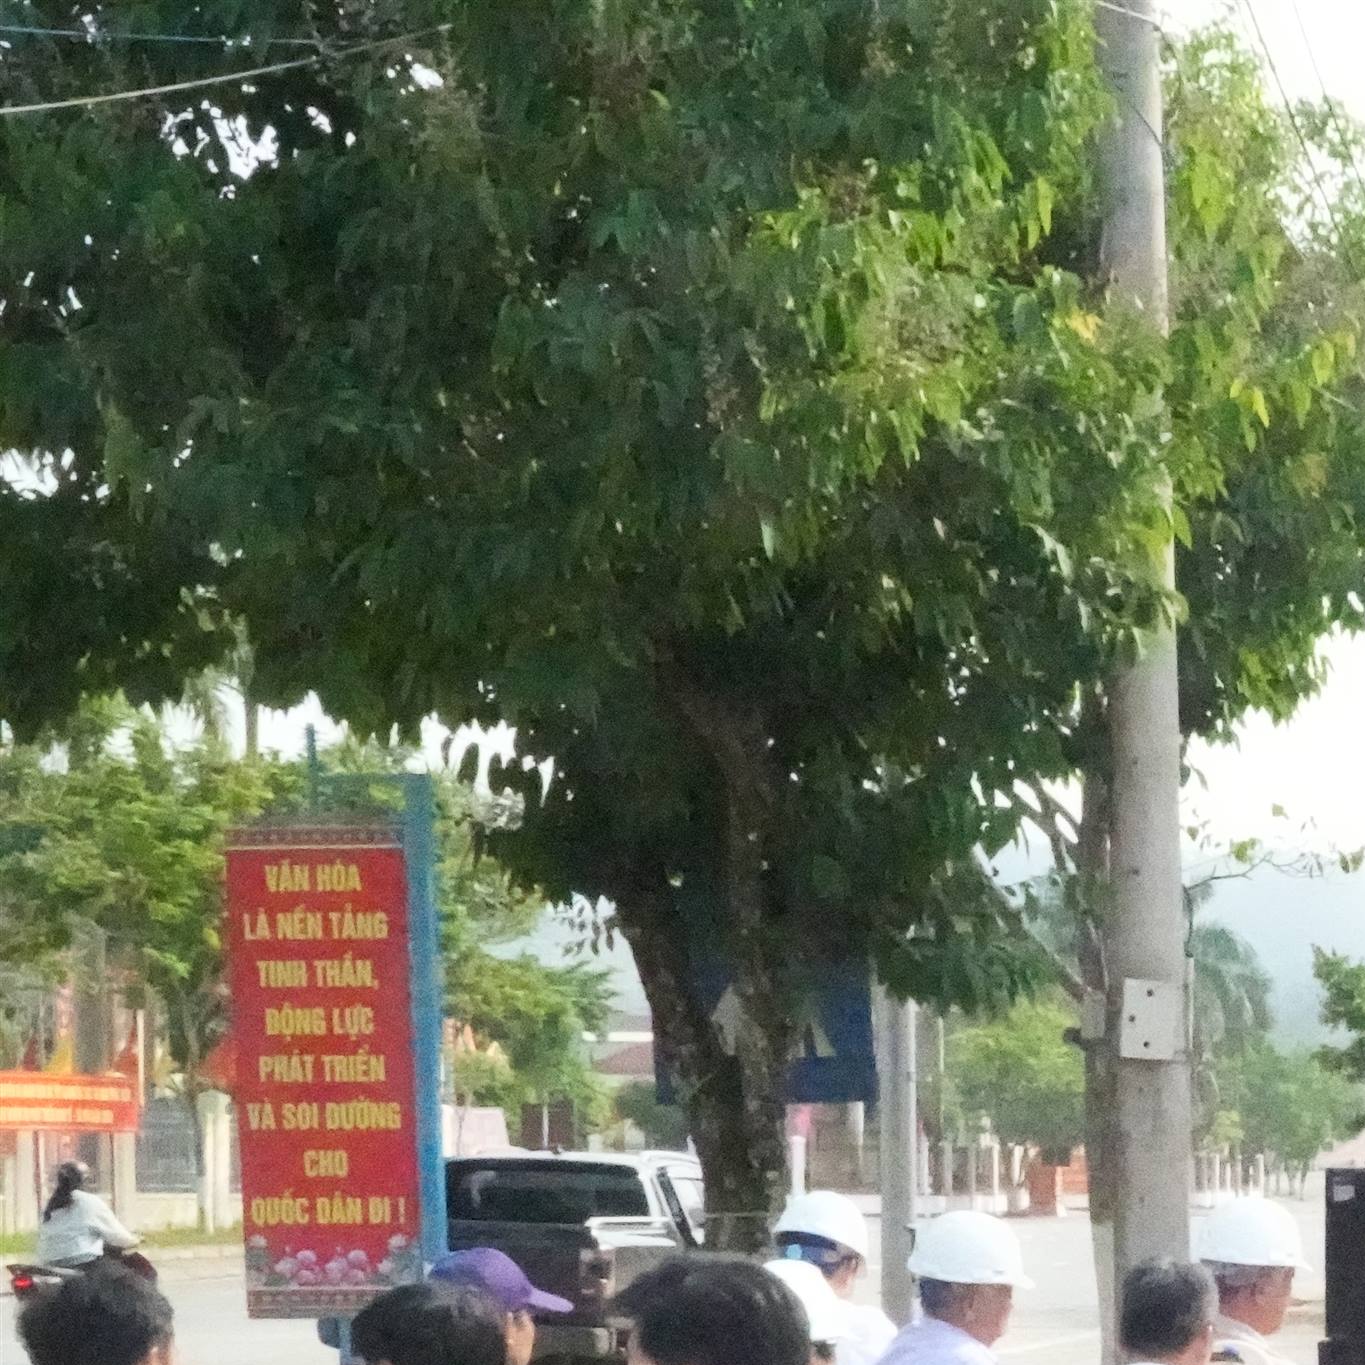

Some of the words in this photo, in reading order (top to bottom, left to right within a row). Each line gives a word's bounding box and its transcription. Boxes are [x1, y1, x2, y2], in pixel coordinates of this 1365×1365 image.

[243, 907, 271, 940] LÀ
[256, 960, 308, 988] TINH
[332, 1002, 375, 1041] LỰC
[259, 1050, 315, 1082] PHÁT
[247, 1097, 276, 1130] VÀ
[282, 1103, 320, 1130] SOI
[303, 1150, 348, 1178] CHO
